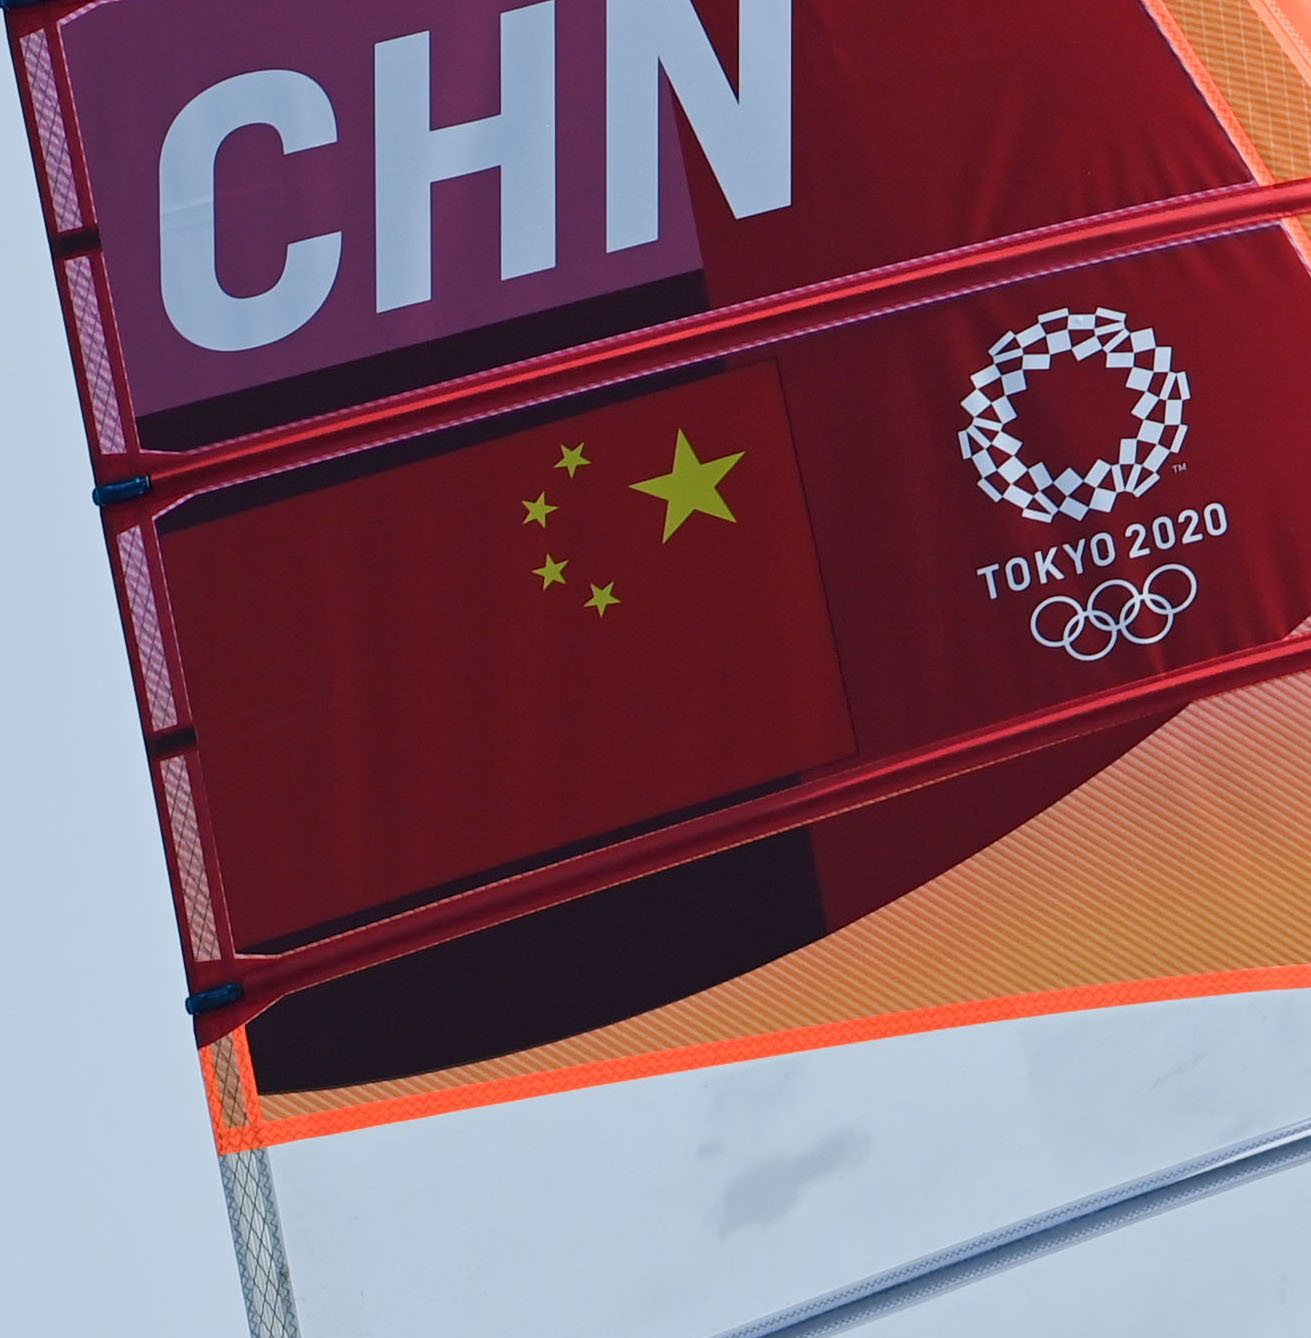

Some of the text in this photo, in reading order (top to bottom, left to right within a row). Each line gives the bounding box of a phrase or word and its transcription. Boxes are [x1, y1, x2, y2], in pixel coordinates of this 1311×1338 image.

[159, 0, 793, 352] CHN
[1172, 463, 1187, 474] TM
[976, 502, 1229, 599] TOKYO 2020
